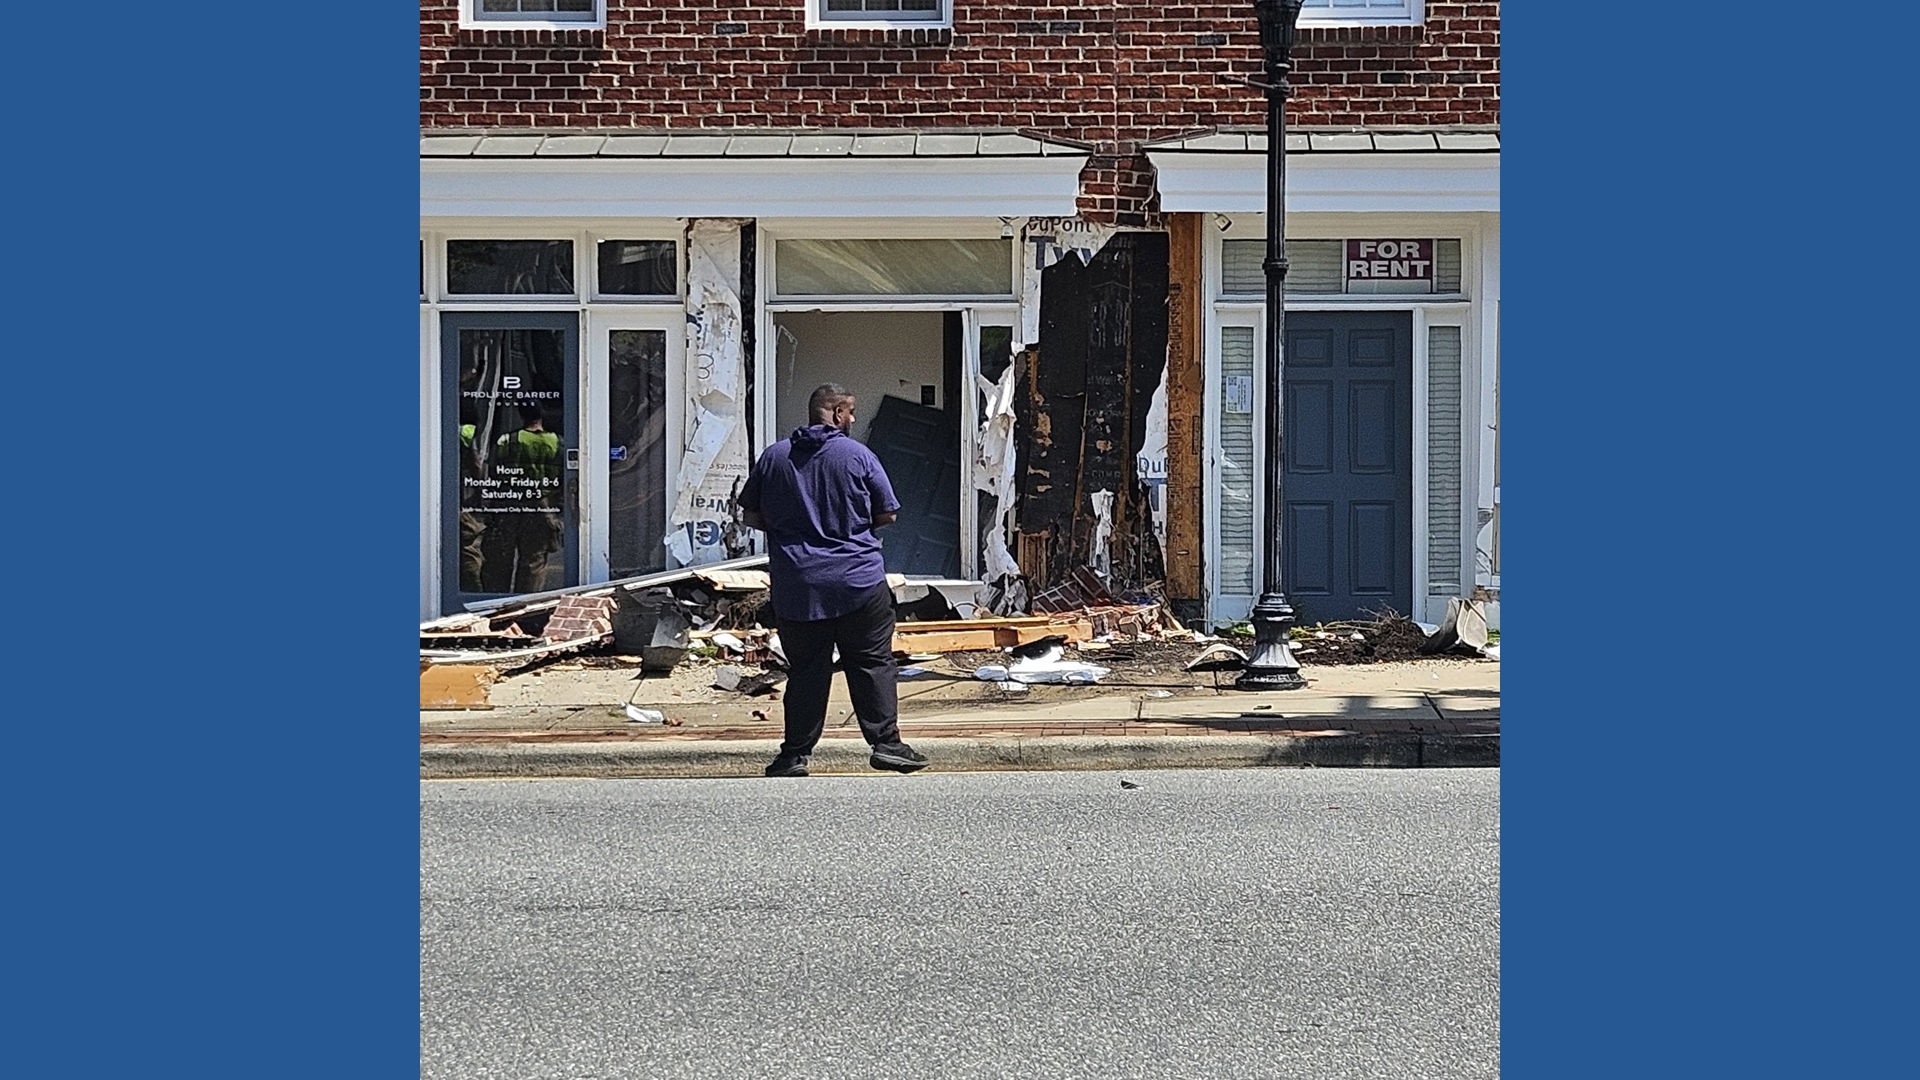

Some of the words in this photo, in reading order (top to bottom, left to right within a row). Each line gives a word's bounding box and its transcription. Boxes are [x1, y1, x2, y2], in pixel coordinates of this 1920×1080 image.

[1359, 241, 1420, 259] FOR
[1349, 260, 1431, 278] RENT
[463, 391, 513, 399] PROLIFIC
[516, 391, 560, 399] BARBER
[496, 465, 524, 475] Hours
[464, 477, 502, 489] Monday
[510, 477, 540, 489] Friday
[542, 477, 560, 487] 8-6
[481, 489, 523, 500] Saturday
[525, 489, 542, 499] 8-3
